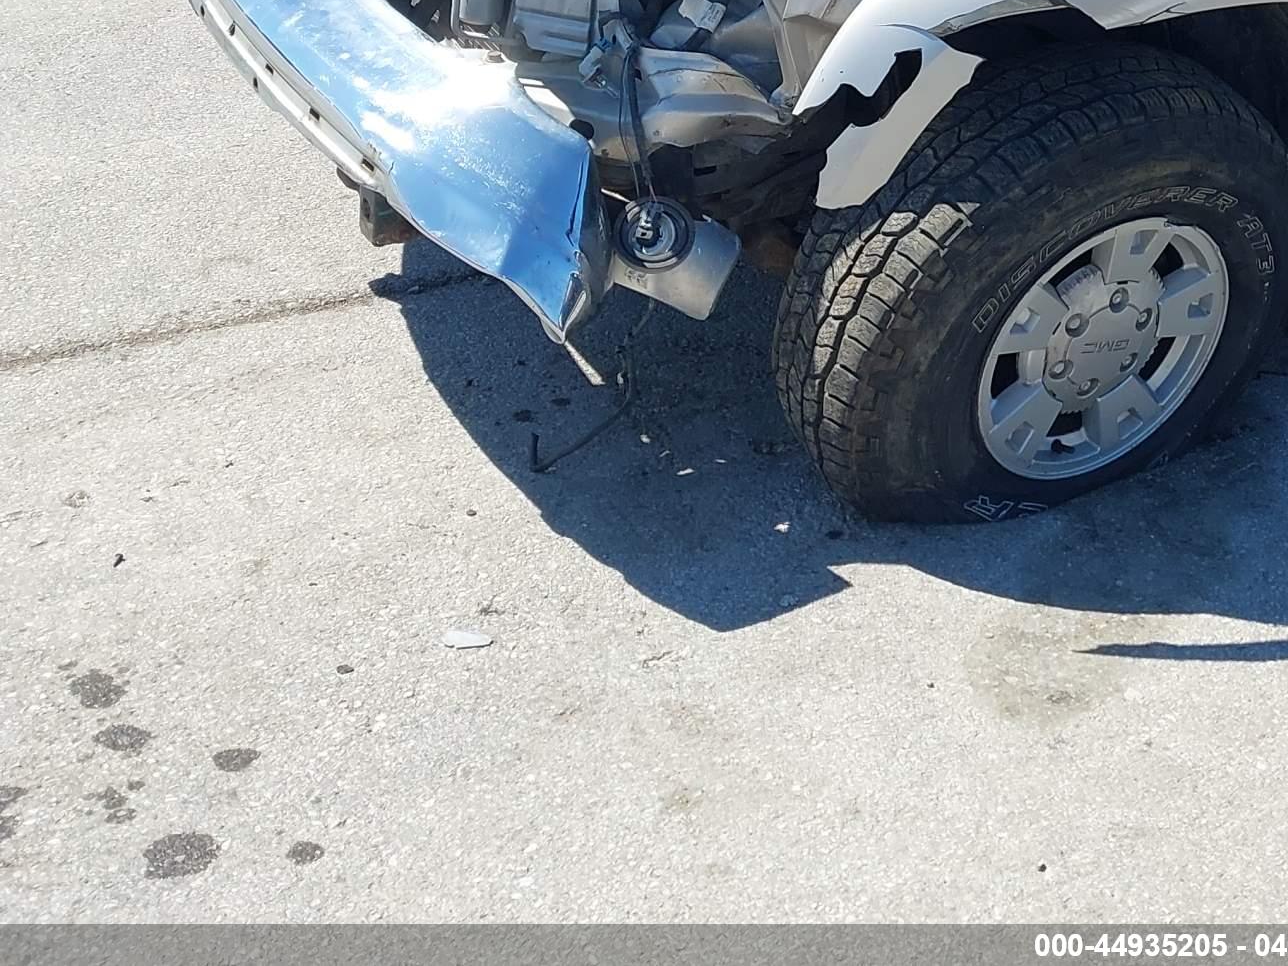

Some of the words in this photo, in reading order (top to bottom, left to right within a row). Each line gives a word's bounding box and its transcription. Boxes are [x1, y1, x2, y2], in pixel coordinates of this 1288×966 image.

[971, 185, 1239, 334] DISCOVERER
[1236, 212, 1276, 276] AT3
[1080, 338, 1130, 354] GMC
